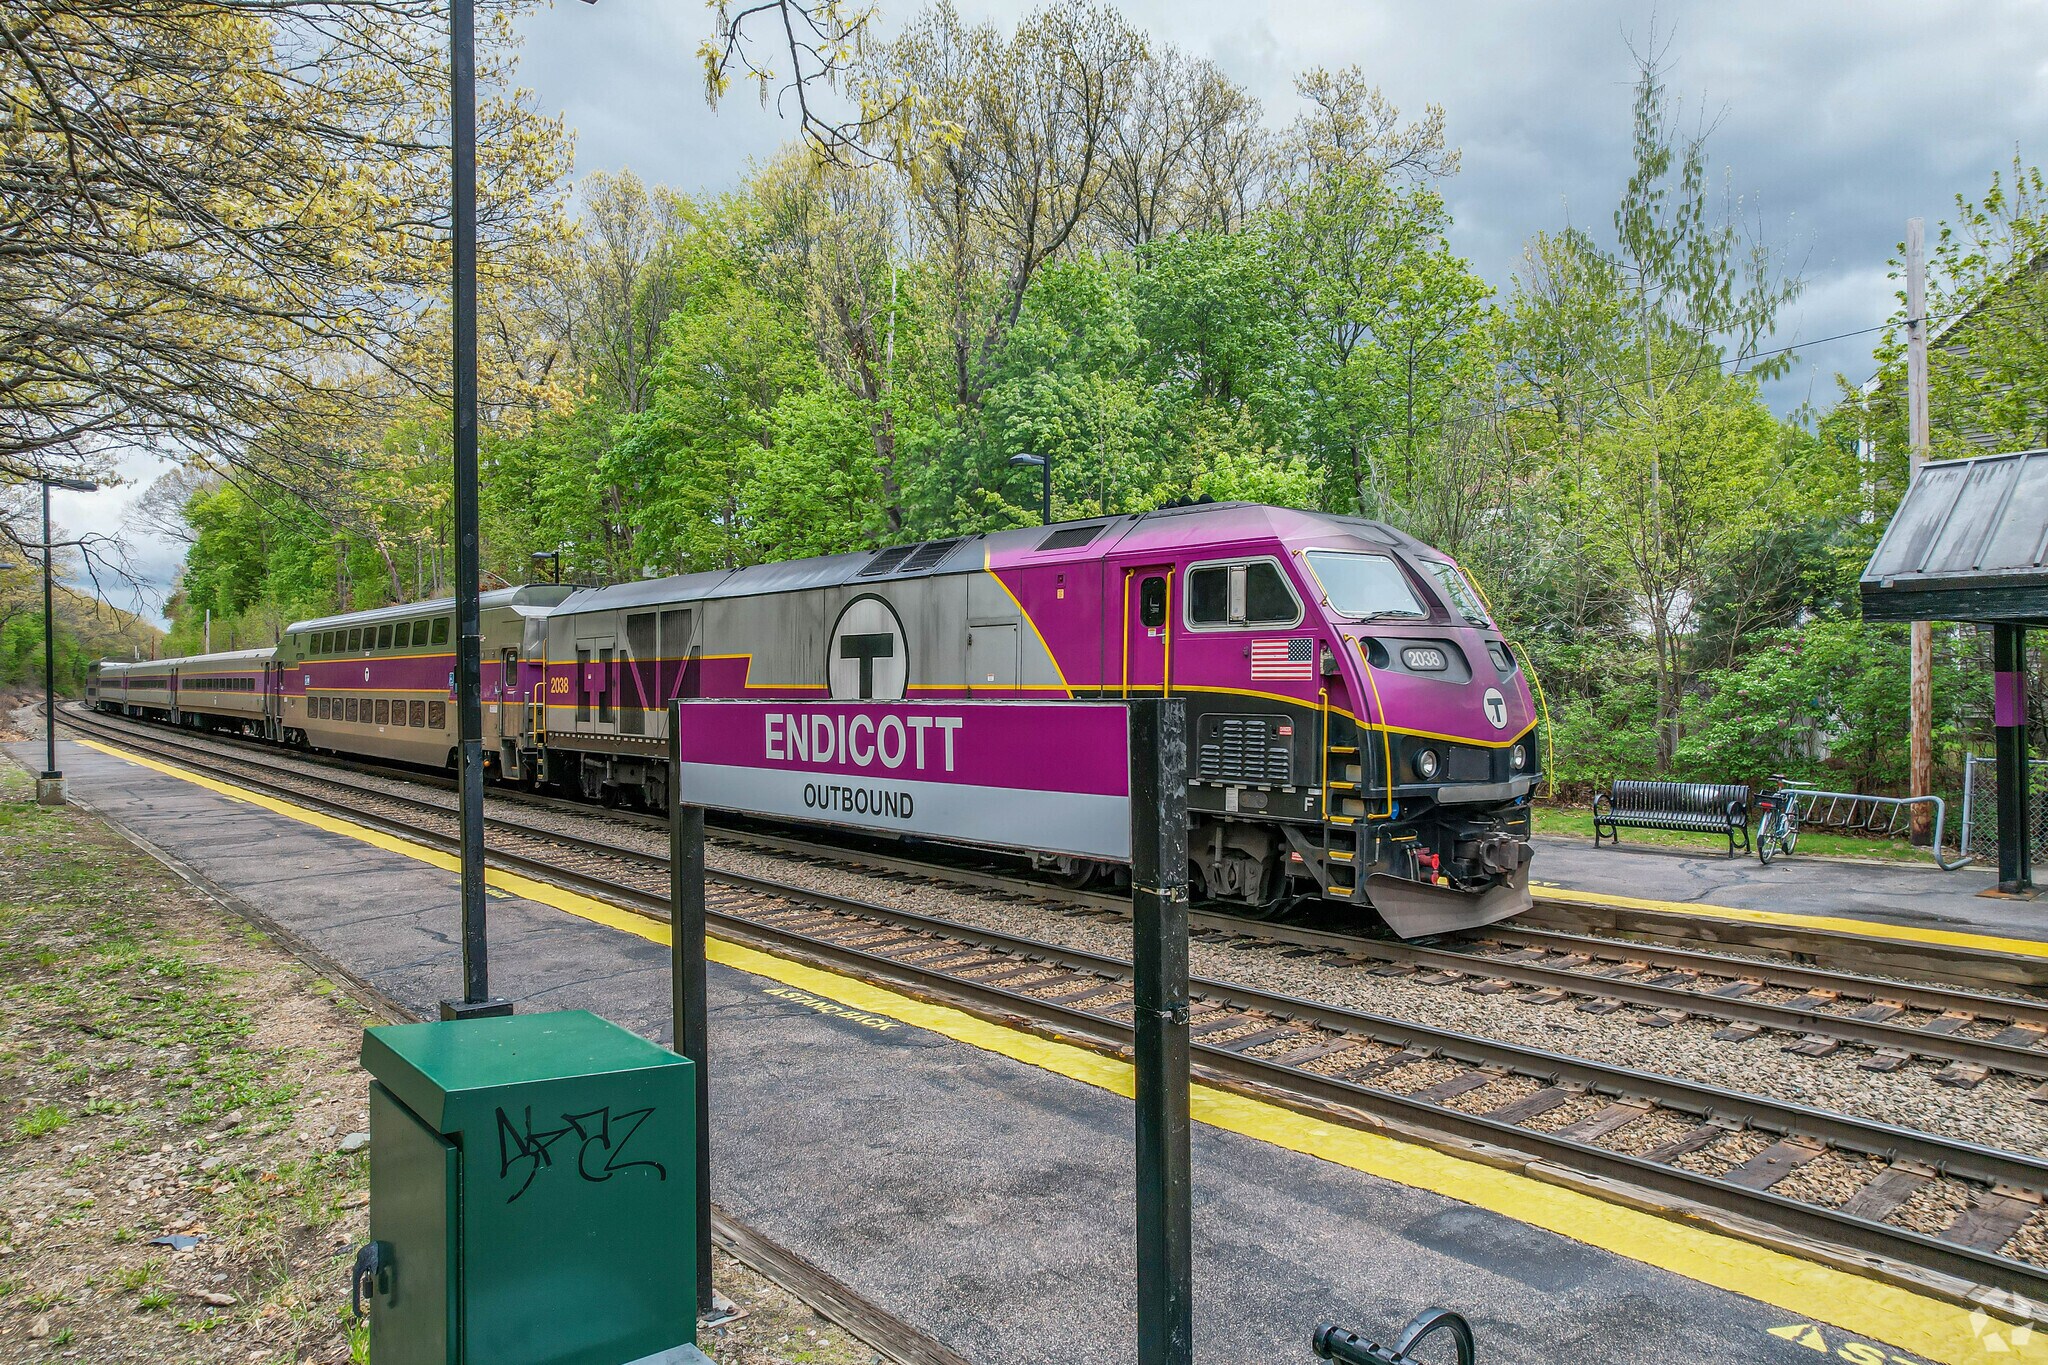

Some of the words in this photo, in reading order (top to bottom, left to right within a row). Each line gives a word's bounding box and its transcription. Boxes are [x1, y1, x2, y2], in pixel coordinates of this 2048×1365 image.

[841, 633, 893, 699] T
[1408, 651, 1440, 666] 2038
[550, 677, 569, 694] 2038
[1487, 698, 1503, 722] T
[765, 713, 963, 772] ENDICOTT
[803, 783, 914, 819] OUTBOUND
[1304, 797, 1314, 811] F
[780, 992, 843, 1014] STAND
[836, 1010, 901, 1031] BACK
